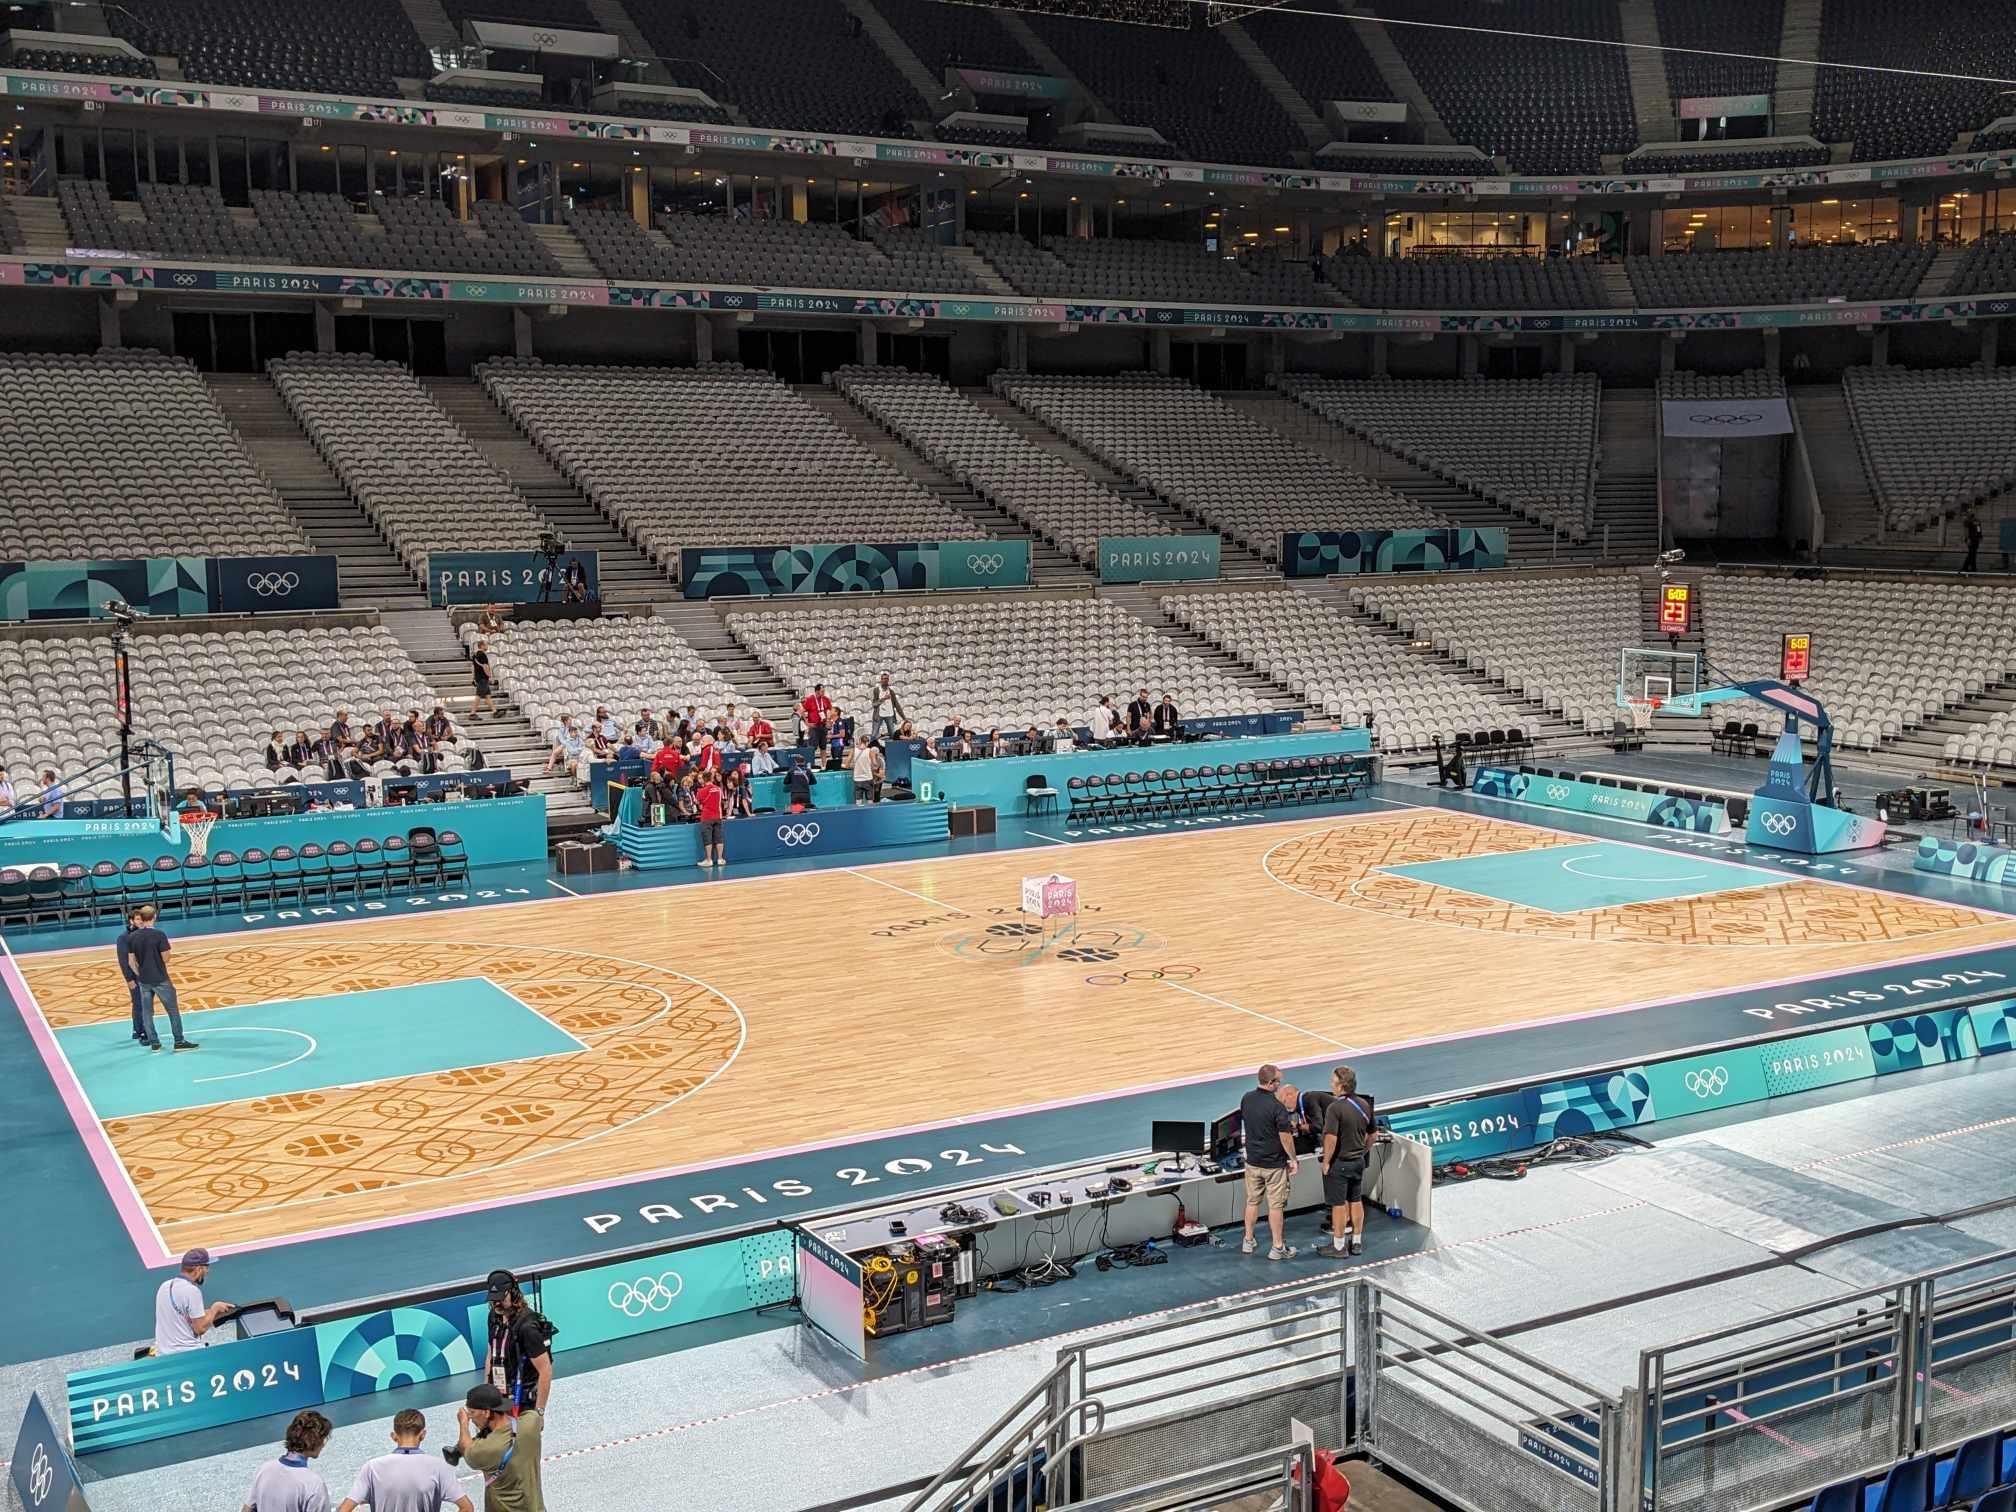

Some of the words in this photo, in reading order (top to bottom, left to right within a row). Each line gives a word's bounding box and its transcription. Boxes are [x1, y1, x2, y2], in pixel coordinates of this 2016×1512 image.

[22, 82, 58, 93] PARIS
[64, 85, 96, 96] 2024
[272, 102, 304, 112] PARIS
[308, 104, 338, 114] 2024
[496, 118, 526, 128] PARIS
[531, 120, 558, 130] 2024
[700, 135, 728, 144] PARIS
[730, 136, 756, 146] 2024
[234, 276, 276, 288] PARIS
[281, 278, 320, 289] 2024
[519, 288, 556, 298] PARIS
[562, 290, 594, 300] 2024
[771, 296, 804, 307] PARIS
[808, 300, 838, 310] 2024
[994, 306, 1024, 316] PARIS
[1027, 308, 1054, 317] 2024
[1194, 313, 1222, 321] PARIS
[1225, 314, 1248, 322] 2024
[1800, 312, 1832, 322] PARIS
[1837, 311, 1868, 320] 2024
[1575, 319, 1606, 328] PARIS
[1609, 319, 1638, 327] 2024
[1110, 551, 1160, 567] PARIS
[1165, 550, 1210, 566] 2024
[442, 570, 512, 588] PARIS
[1664, 602, 1684, 622] 23
[1787, 652, 1806, 669] 23
[1770, 770, 1790, 779] PARIS
[1770, 777, 1791, 786] 2024
[1592, 794, 1619, 807] PARIS
[1621, 798, 1647, 812] 2024
[85, 823, 120, 832] PARIS
[124, 822, 156, 830] 2024
[1064, 822, 1166, 837] PARIS
[1174, 812, 1264, 826] 2024
[1644, 833, 1750, 855] PARIS
[1752, 852, 1858, 875] 2024
[1048, 888, 1072, 900] PARIS
[243, 902, 388, 923] PARIS
[406, 888, 530, 905] 2024
[1048, 898, 1072, 908] 2024
[870, 912, 972, 936] PARIS
[1743, 990, 1886, 1019] PARIS
[1883, 970, 2006, 995] 2024
[1772, 1054, 1819, 1076] PARIS
[1824, 1046, 1864, 1066] 2024
[1469, 1114, 1518, 1137] 2024
[582, 1179, 812, 1234] PARIS
[836, 1143, 1026, 1186] 2024
[808, 1239, 829, 1260] PARIS
[830, 1256, 849, 1275] 2024
[93, 1380, 196, 1422] PARIS
[210, 1360, 300, 1398] 2024
[1523, 1436, 1546, 1454] PARIS
[1548, 1450, 1570, 1467] 2024
[1578, 1465, 1598, 1482] PARI
